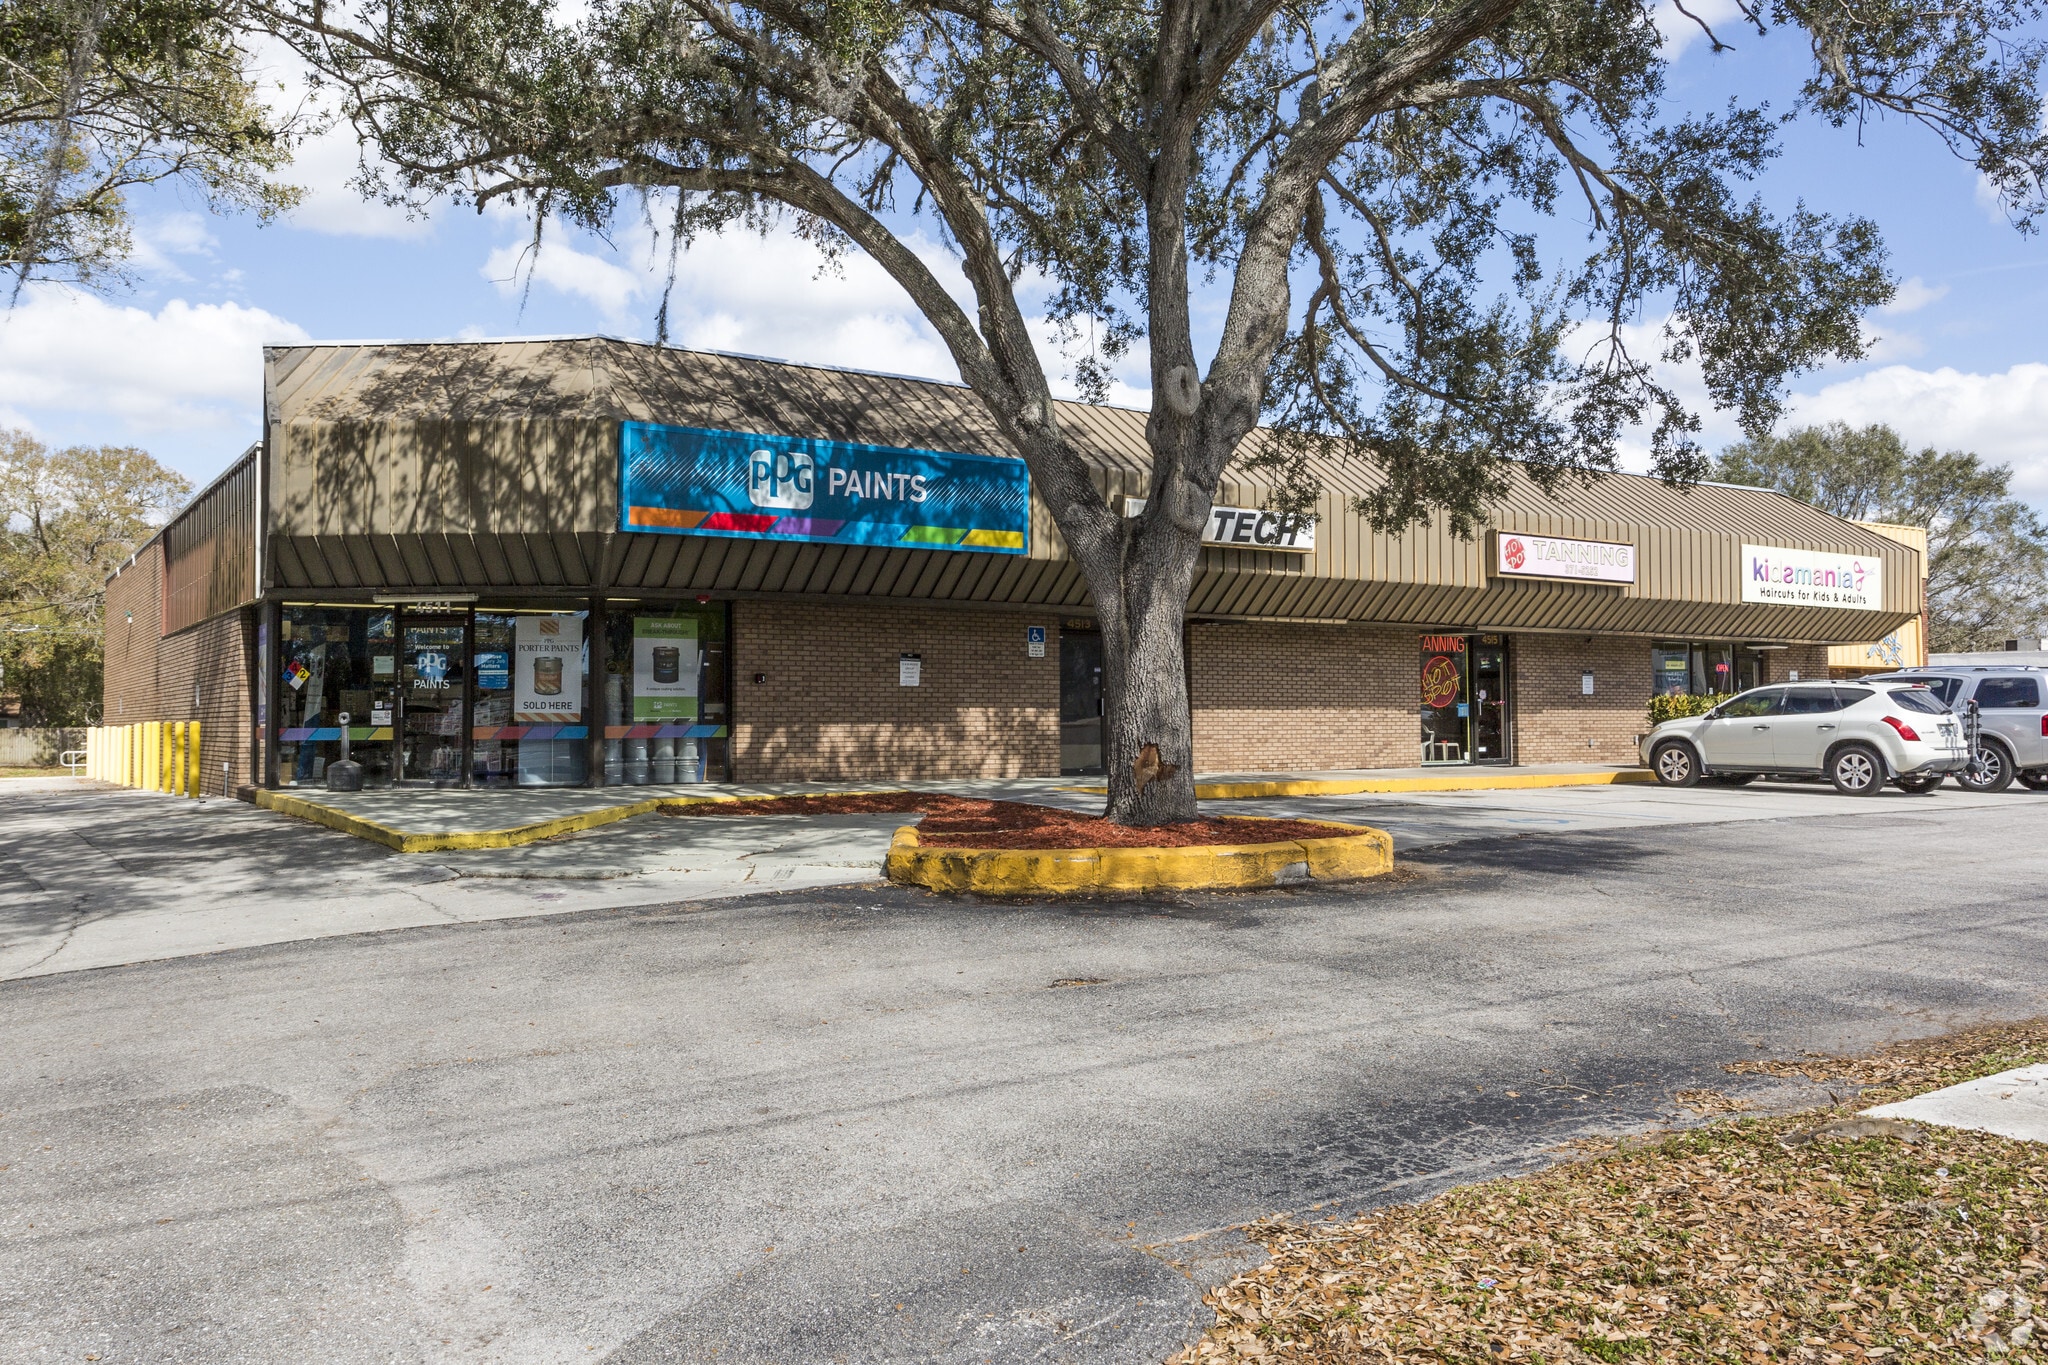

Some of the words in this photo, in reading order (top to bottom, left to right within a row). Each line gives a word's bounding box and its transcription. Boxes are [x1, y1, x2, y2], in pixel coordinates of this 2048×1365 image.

[752, 450, 812, 498] PPG
[829, 467, 928, 503] PAINTS
[1214, 510, 1305, 546] TECH
[1533, 540, 1628, 567] TANNING
[1753, 557, 1853, 589] kidsmania
[1760, 587, 1794, 599] Haircuts
[1798, 590, 1809, 600] for
[1813, 591, 1829, 602] Kids
[1833, 593, 1839, 602] &
[1842, 594, 1867, 605] Adults
[415, 601, 451, 614] 4511
[1067, 619, 1092, 629] 4513
[1482, 635, 1498, 645] 4515
[518, 644, 547, 652] PORTER
[551, 644, 580, 652] PAINTS
[418, 652, 447, 673] PPG
[286, 671, 292, 680] 3
[300, 669, 306, 679] 2
[413, 680, 450, 689] PAINTS
[523, 701, 546, 710] SOLD
[548, 701, 573, 710] HERE
